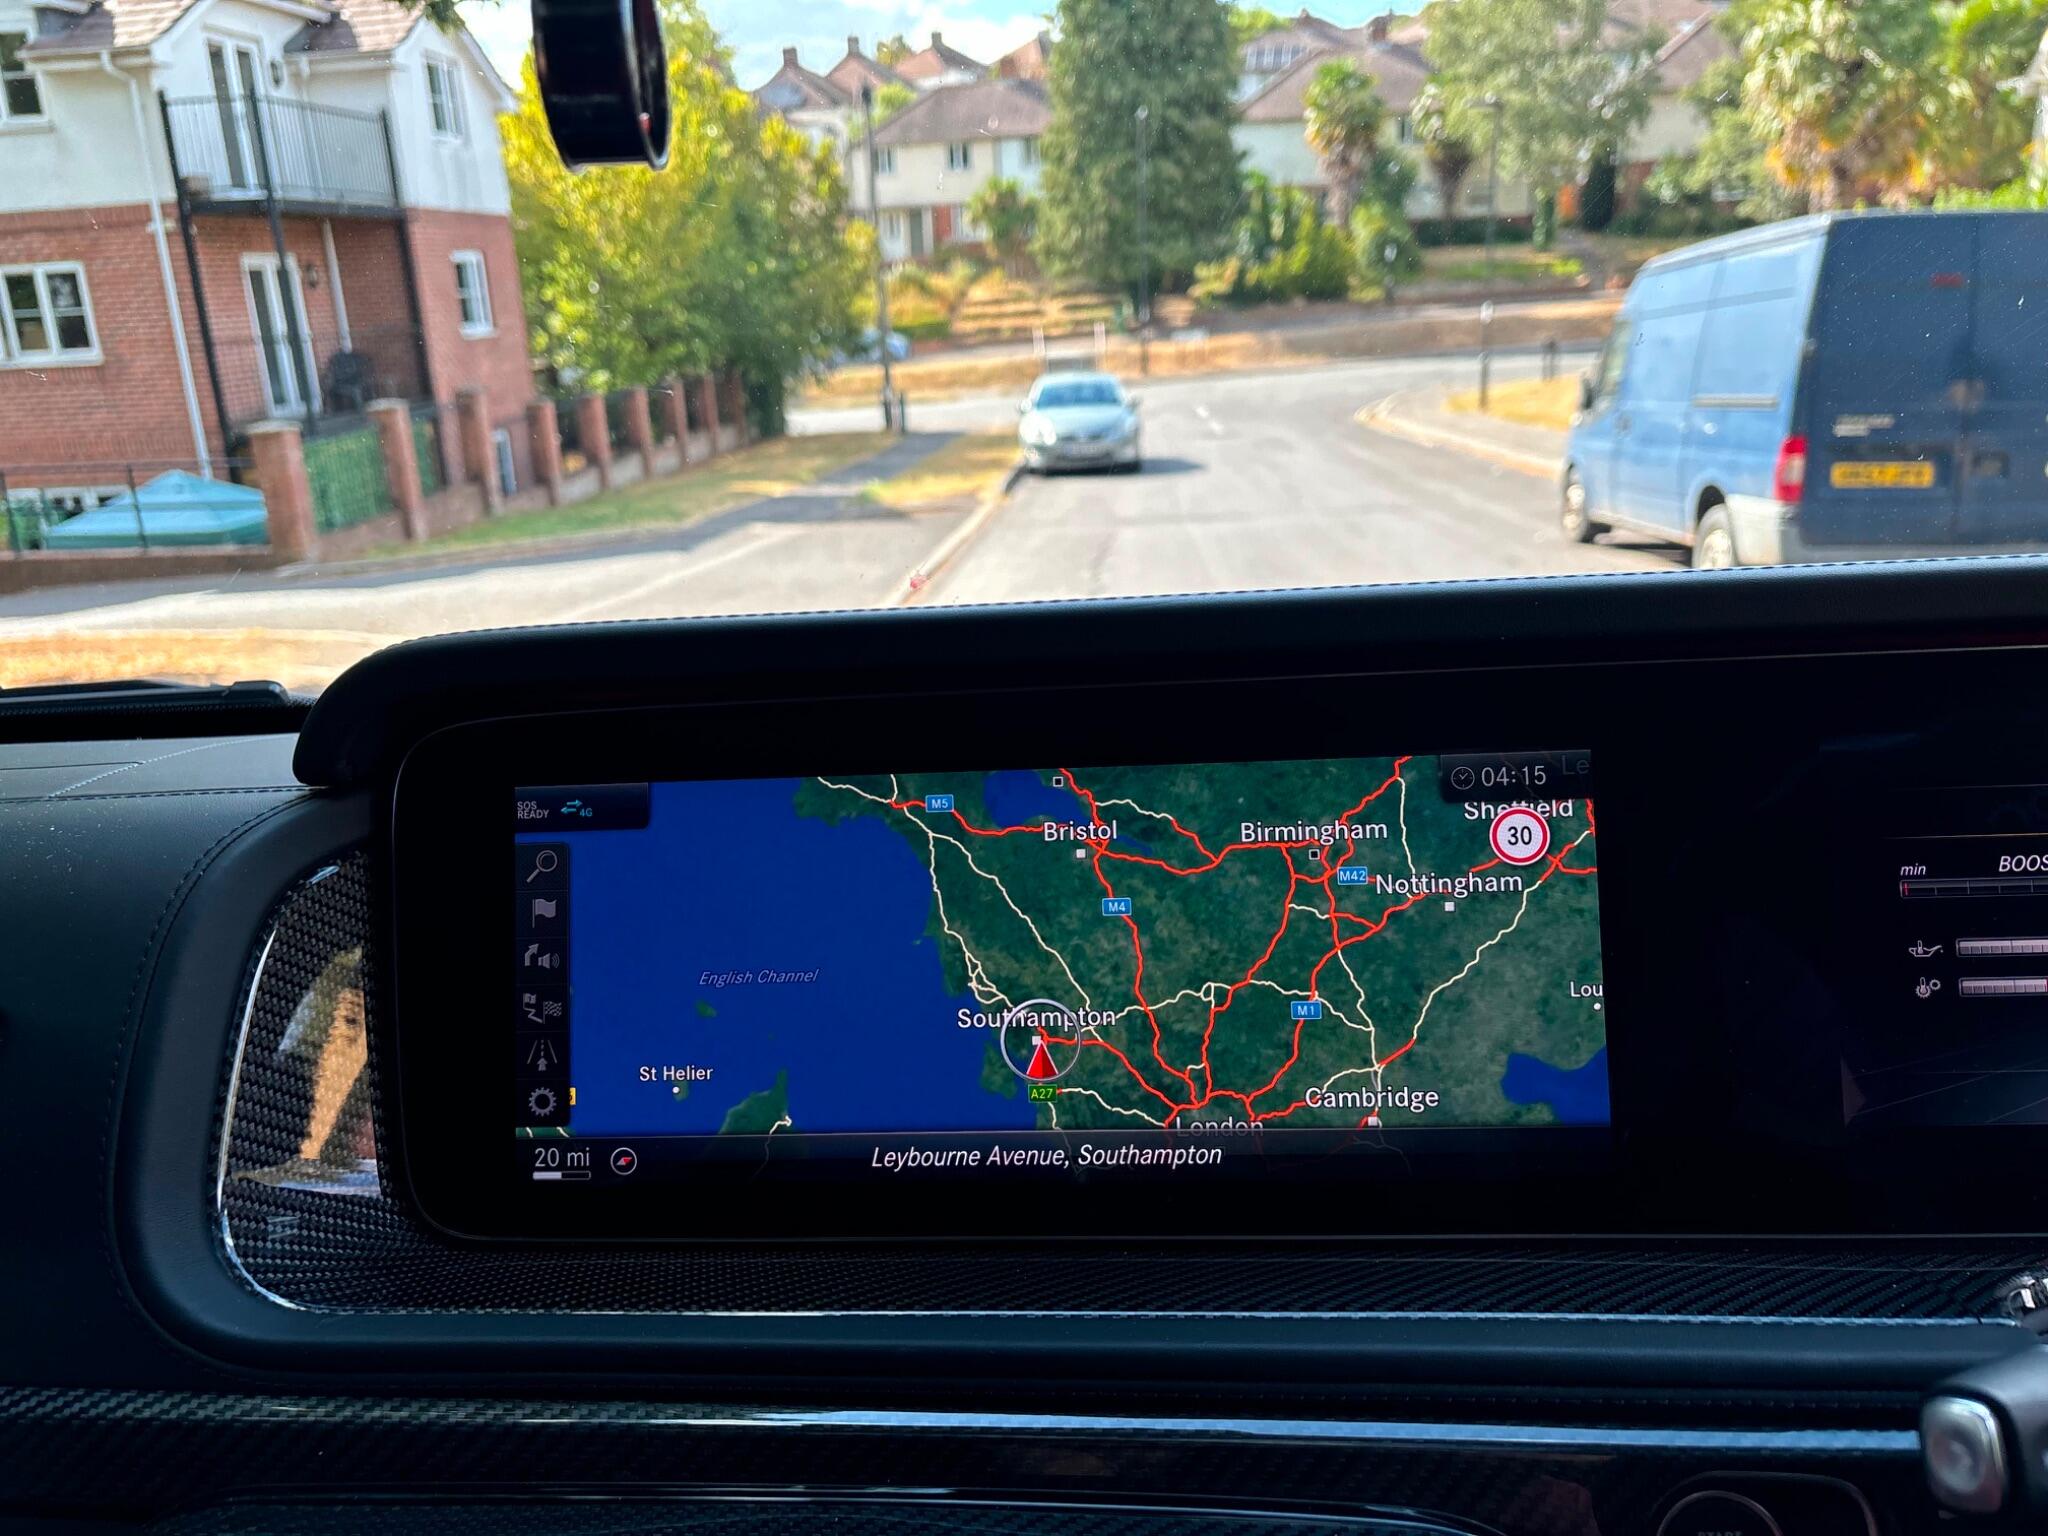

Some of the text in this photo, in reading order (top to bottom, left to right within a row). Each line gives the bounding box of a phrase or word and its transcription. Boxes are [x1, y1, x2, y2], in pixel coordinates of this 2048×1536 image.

[1480, 766, 1547, 788] 04:15
[517, 801, 537, 811] SOS
[931, 796, 949, 810] M5
[517, 810, 549, 819] READY
[579, 808, 593, 817] 4G
[1043, 820, 1118, 843] Bristol
[1240, 822, 1388, 847] Birmingham
[1507, 827, 1533, 847] 30
[1339, 869, 1366, 883] M42
[1900, 863, 1926, 876] min
[1375, 874, 1523, 898] Nottingham
[1108, 899, 1126, 914] M4
[699, 969, 819, 987] English Channel
[1570, 981, 1602, 997] Lou
[1297, 1003, 1316, 1017] M1
[957, 1008, 1116, 1033] Southampton
[639, 1064, 713, 1081] St Helier
[1031, 1087, 1052, 1099] A27
[1305, 1087, 1439, 1112] Cambridge
[1176, 1116, 1263, 1136] London
[535, 1147, 591, 1167] 20 mi
[871, 1144, 1223, 1171] Leybourne Avenue, Southampton
